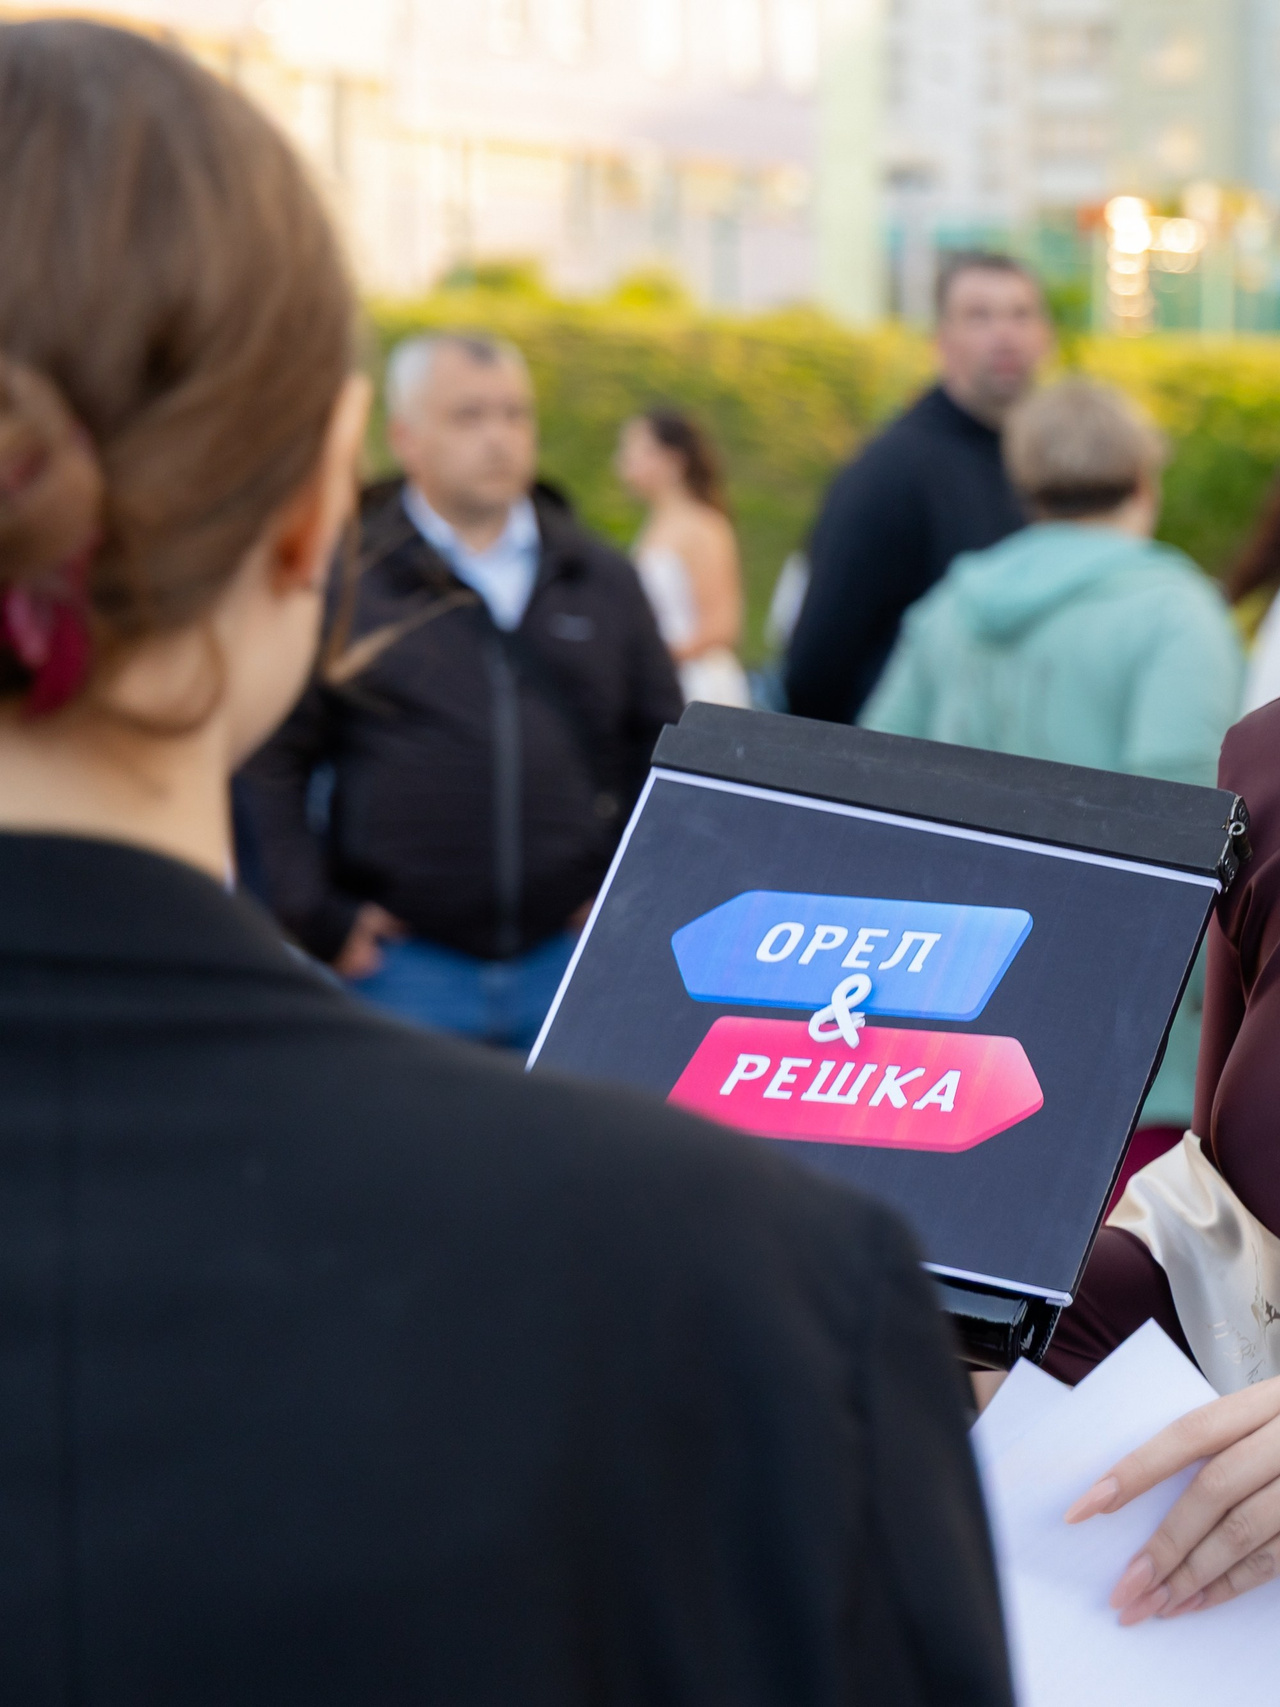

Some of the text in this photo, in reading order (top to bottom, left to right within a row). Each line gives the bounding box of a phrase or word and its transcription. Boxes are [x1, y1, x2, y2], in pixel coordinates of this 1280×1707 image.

[755, 922, 942, 973] ОРЕЛ
[808, 974, 872, 1049] &
[720, 1054, 961, 1112] РЕШКА
